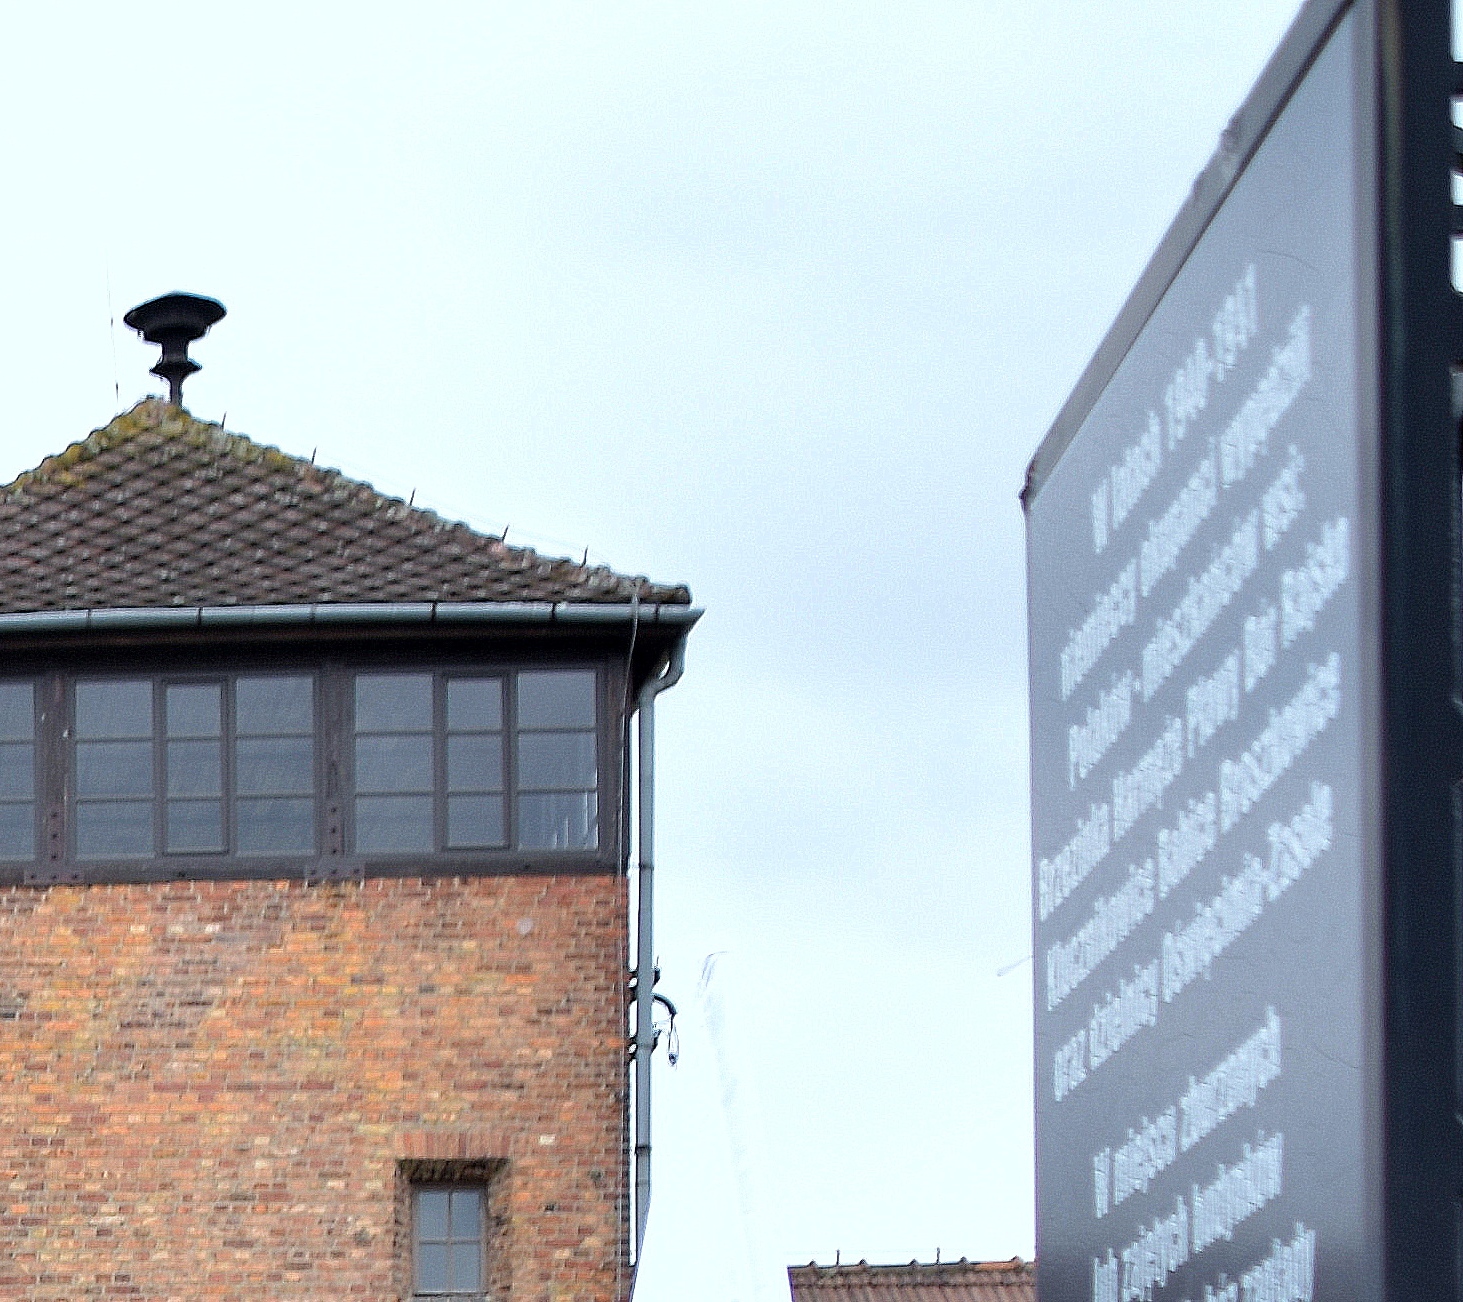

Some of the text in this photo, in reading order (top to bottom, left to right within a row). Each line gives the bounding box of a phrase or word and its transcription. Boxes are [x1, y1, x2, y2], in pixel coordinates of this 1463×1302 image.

[1091, 263, 1257, 553] W latach 1940-1941
[1061, 559, 1136, 699] niemieccy
[1140, 437, 1216, 596] okupanci
[1069, 670, 1132, 790] Polaków
[1142, 510, 1258, 702] mieszkańców
[1041, 803, 1109, 919] Brzezinka
[1048, 859, 1155, 1009] Klucznikowice
[1157, 792, 1216, 897] Babice
[1054, 1029, 1087, 1101] oraz
[1089, 965, 1158, 1070] dzielnicy
[1093, 1005, 1281, 1219] W miejsce zburzonych
[1193, 1130, 1284, 1252] budynków
